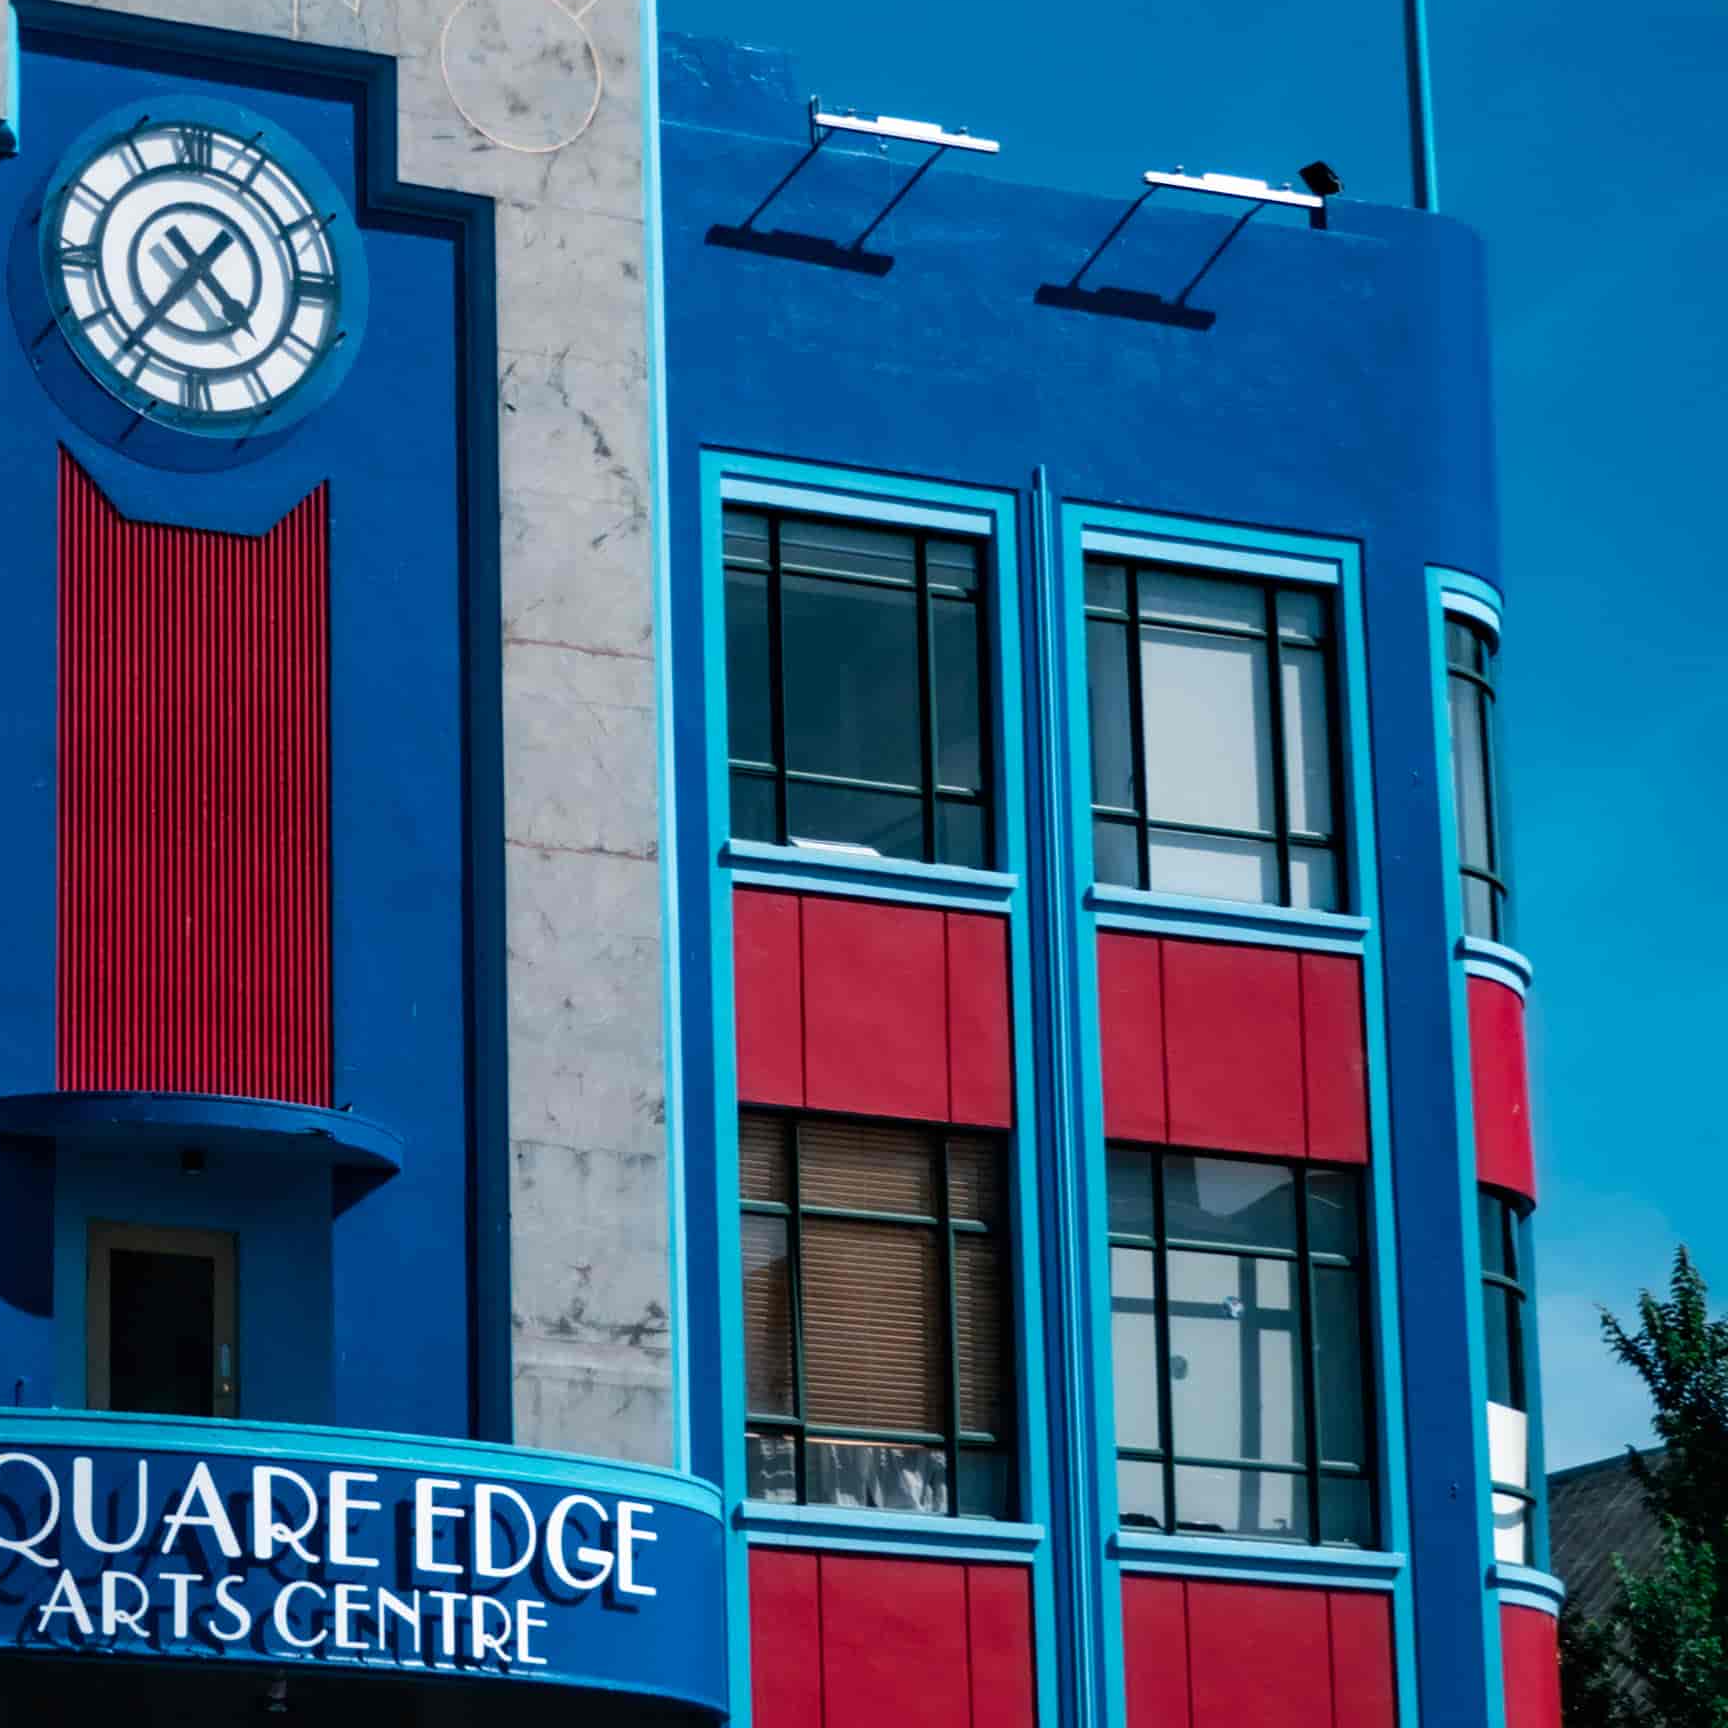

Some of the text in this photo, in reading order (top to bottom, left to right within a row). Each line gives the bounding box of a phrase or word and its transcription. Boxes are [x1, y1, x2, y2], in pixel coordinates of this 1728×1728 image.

[415, 1478, 658, 1597] EDGE
[37, 1568, 548, 1666] ARTS CENTRE
